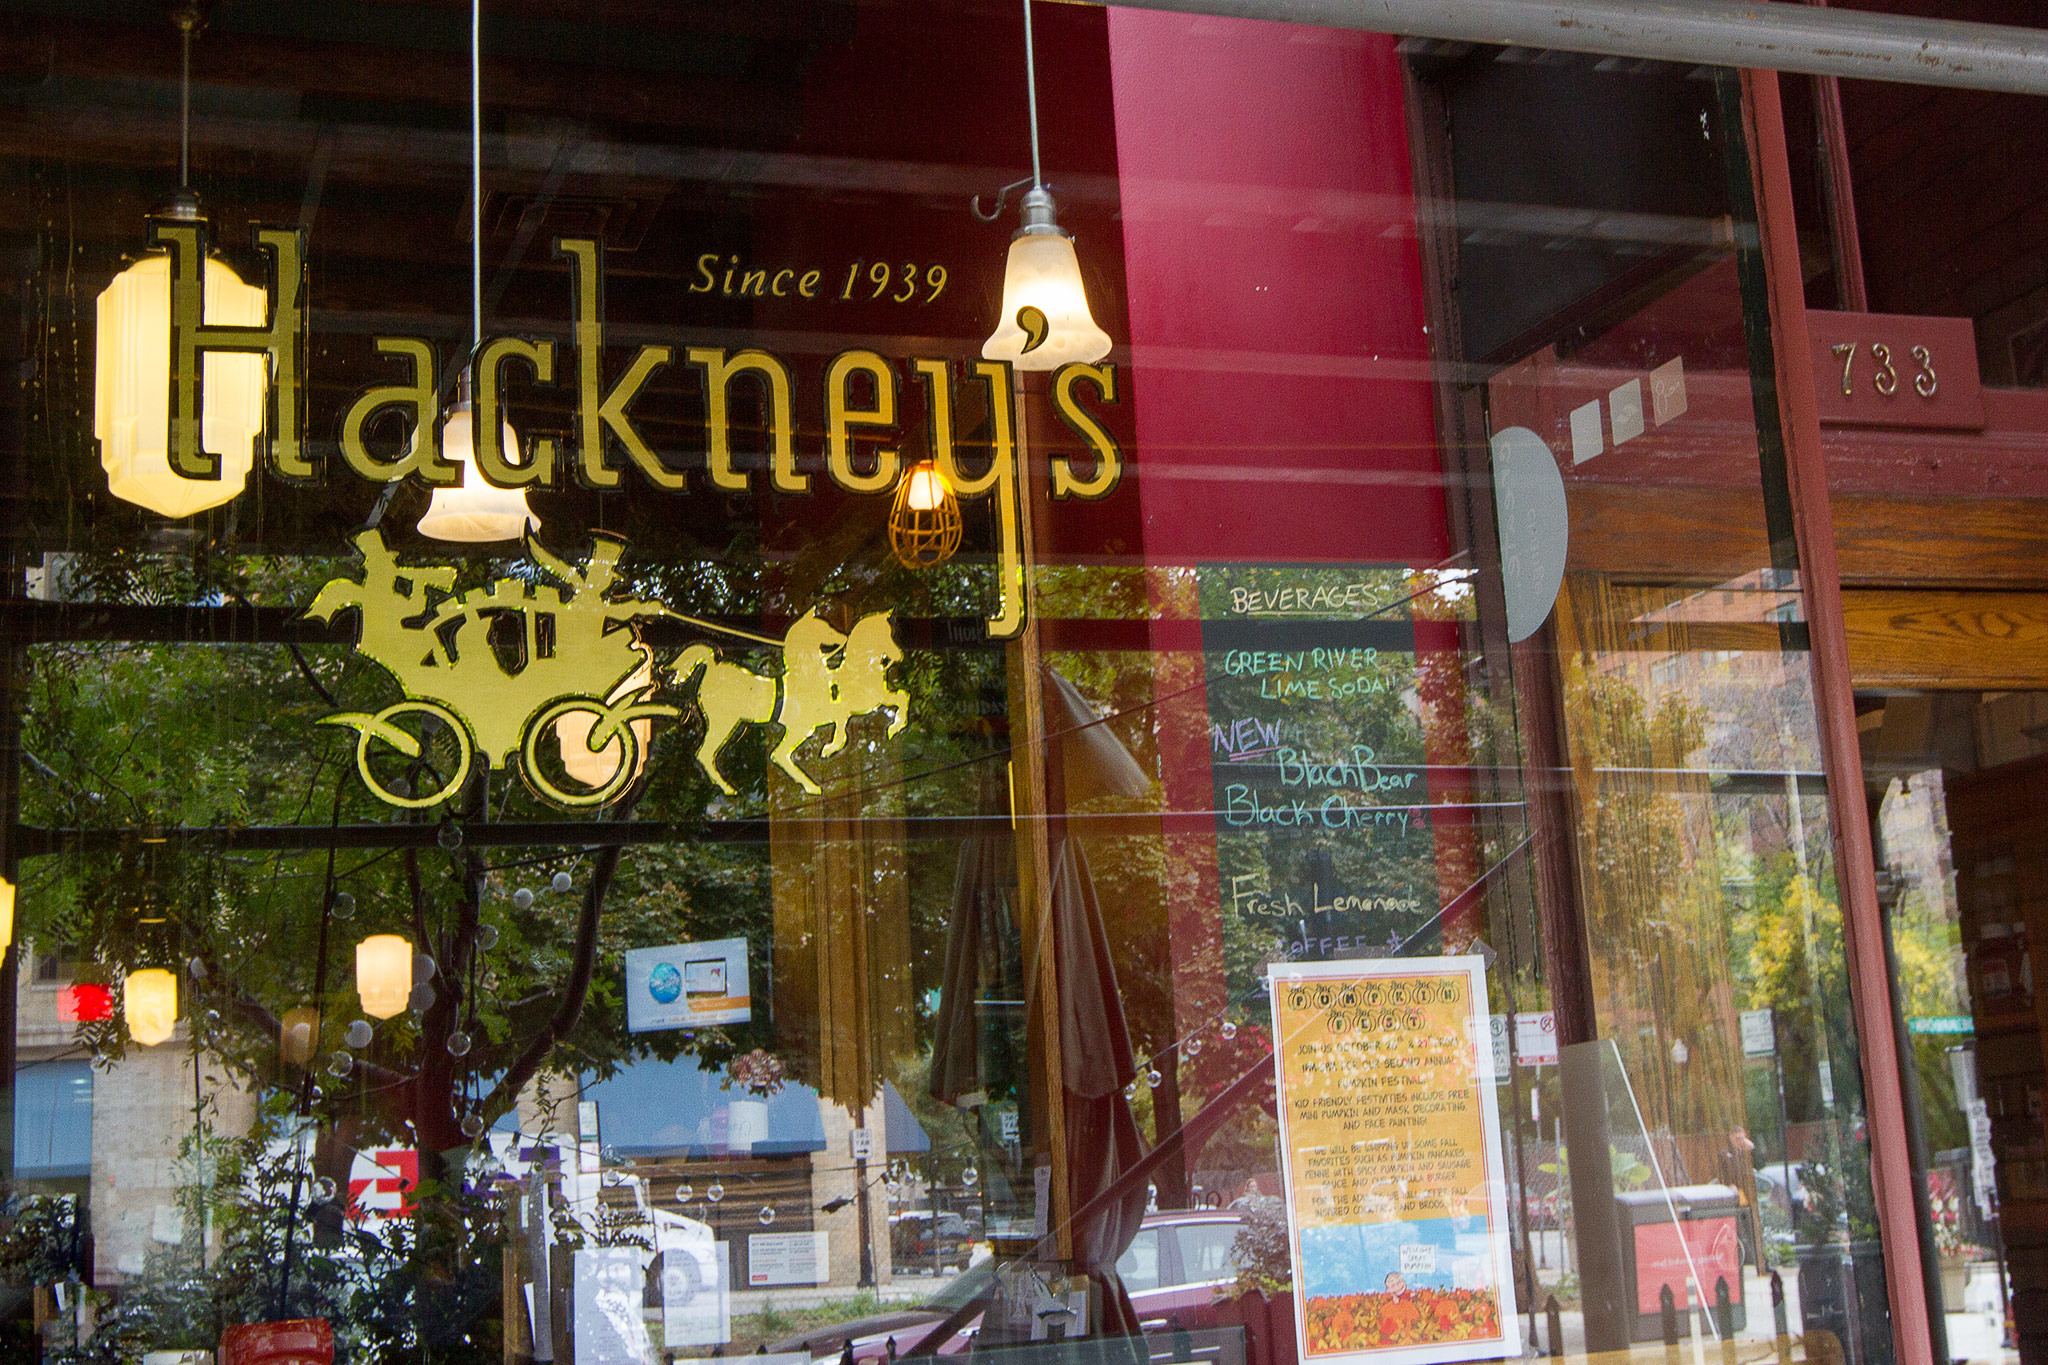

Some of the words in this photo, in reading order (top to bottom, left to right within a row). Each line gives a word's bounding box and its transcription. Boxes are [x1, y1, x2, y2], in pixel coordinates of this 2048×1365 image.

[689, 253, 820, 297] Since
[841, 261, 948, 302] 1939
[1832, 341, 1937, 397] 733
[148, 217, 1122, 639] Hackney's
[1230, 584, 1379, 614] BEVERAGES
[1225, 649, 1304, 676] GREEN
[1312, 647, 1378, 672] RIVER
[1261, 678, 1323, 700] LIME
[1214, 717, 1283, 753] NEW
[1225, 783, 1314, 827] Black
[1321, 795, 1409, 838] Cherry
[1232, 873, 1304, 918] Fresh
[1298, 1044, 1317, 1055] JOIN
[1321, 1043, 1332, 1053] US
[1337, 1077, 1378, 1089] PUMPKIN
[1295, 1098, 1309, 1109] KID
[1313, 1095, 1352, 1108] FRIENDLY
[1448, 1088, 1469, 1100] FREE
[1321, 1108, 1359, 1119] PUMPKIN
[1363, 1106, 1380, 1117] AND
[1385, 1104, 1409, 1115] MASK
[1343, 1120, 1360, 1130] AND
[1364, 1118, 1385, 1129] FACE
[1440, 1137, 1458, 1147] FALL
